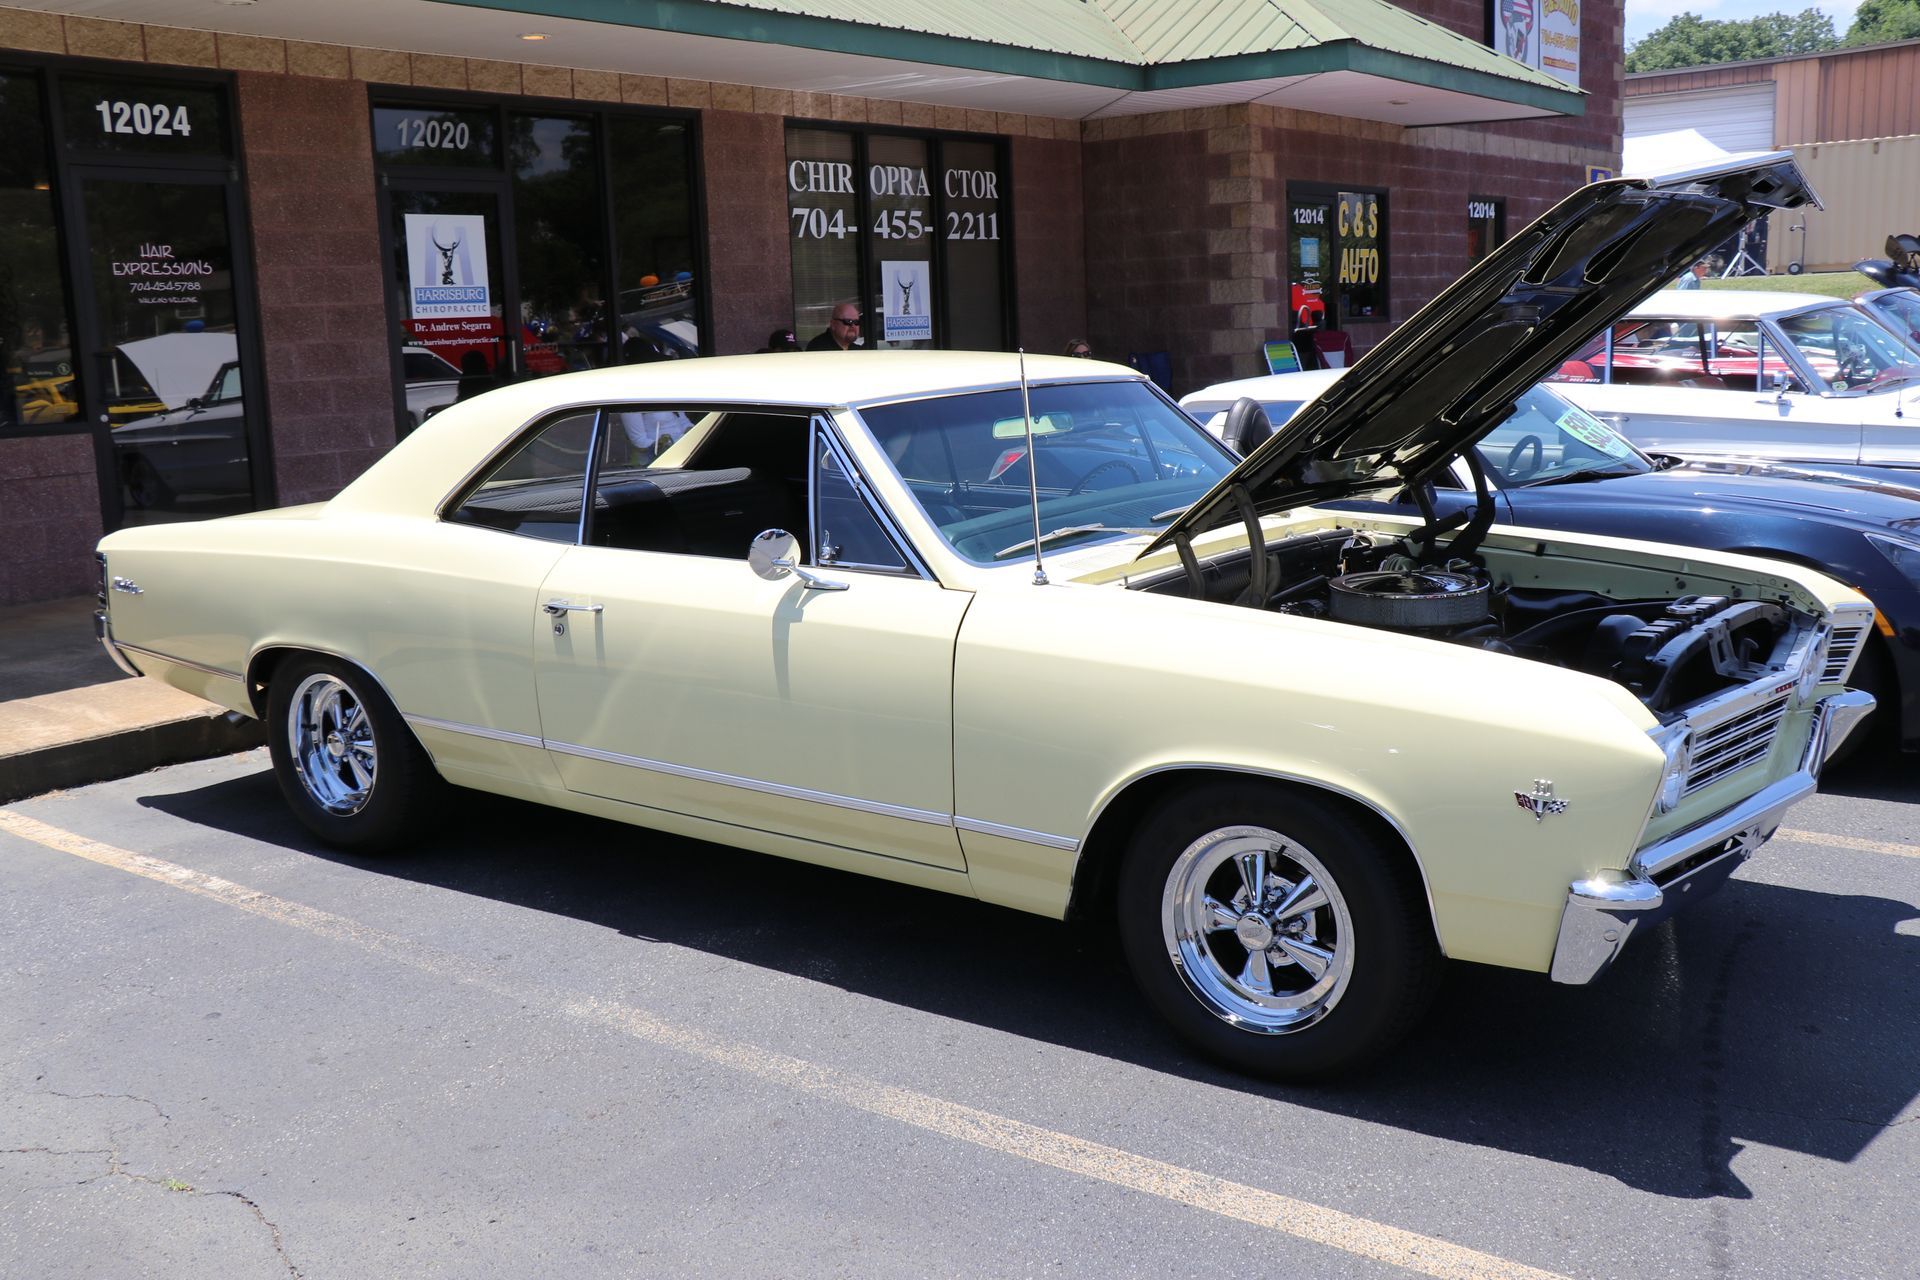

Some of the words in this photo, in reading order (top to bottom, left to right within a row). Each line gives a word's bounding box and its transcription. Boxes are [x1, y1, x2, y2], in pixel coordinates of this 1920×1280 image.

[95, 100, 191, 137] 12024
[397, 118, 470, 150] 12020
[789, 160, 855, 194] CHIR
[869, 165, 931, 197] OPRA
[944, 168, 999, 200] CTOR
[1293, 208, 1325, 224] 12014
[1468, 201, 1496, 219] 12014
[791, 207, 858, 240] 704-
[873, 209, 934, 240] 455-
[946, 211, 1000, 240] 2211
[1338, 200, 1349, 237] C
[1353, 201, 1364, 238] &
[1368, 202, 1378, 238] S
[140, 242, 175, 258] HAIR
[112, 260, 213, 276] EXPRESSIONS
[1339, 248, 1379, 284] AUTO
[416, 288, 485, 301] HARRISBURG
[415, 304, 487, 314] CHIROPRACTIC
[414, 323, 429, 332] Dr.
[430, 322, 460, 332] Andrew
[462, 321, 492, 333] Segarra
[887, 317, 928, 327] HARRISBURG
